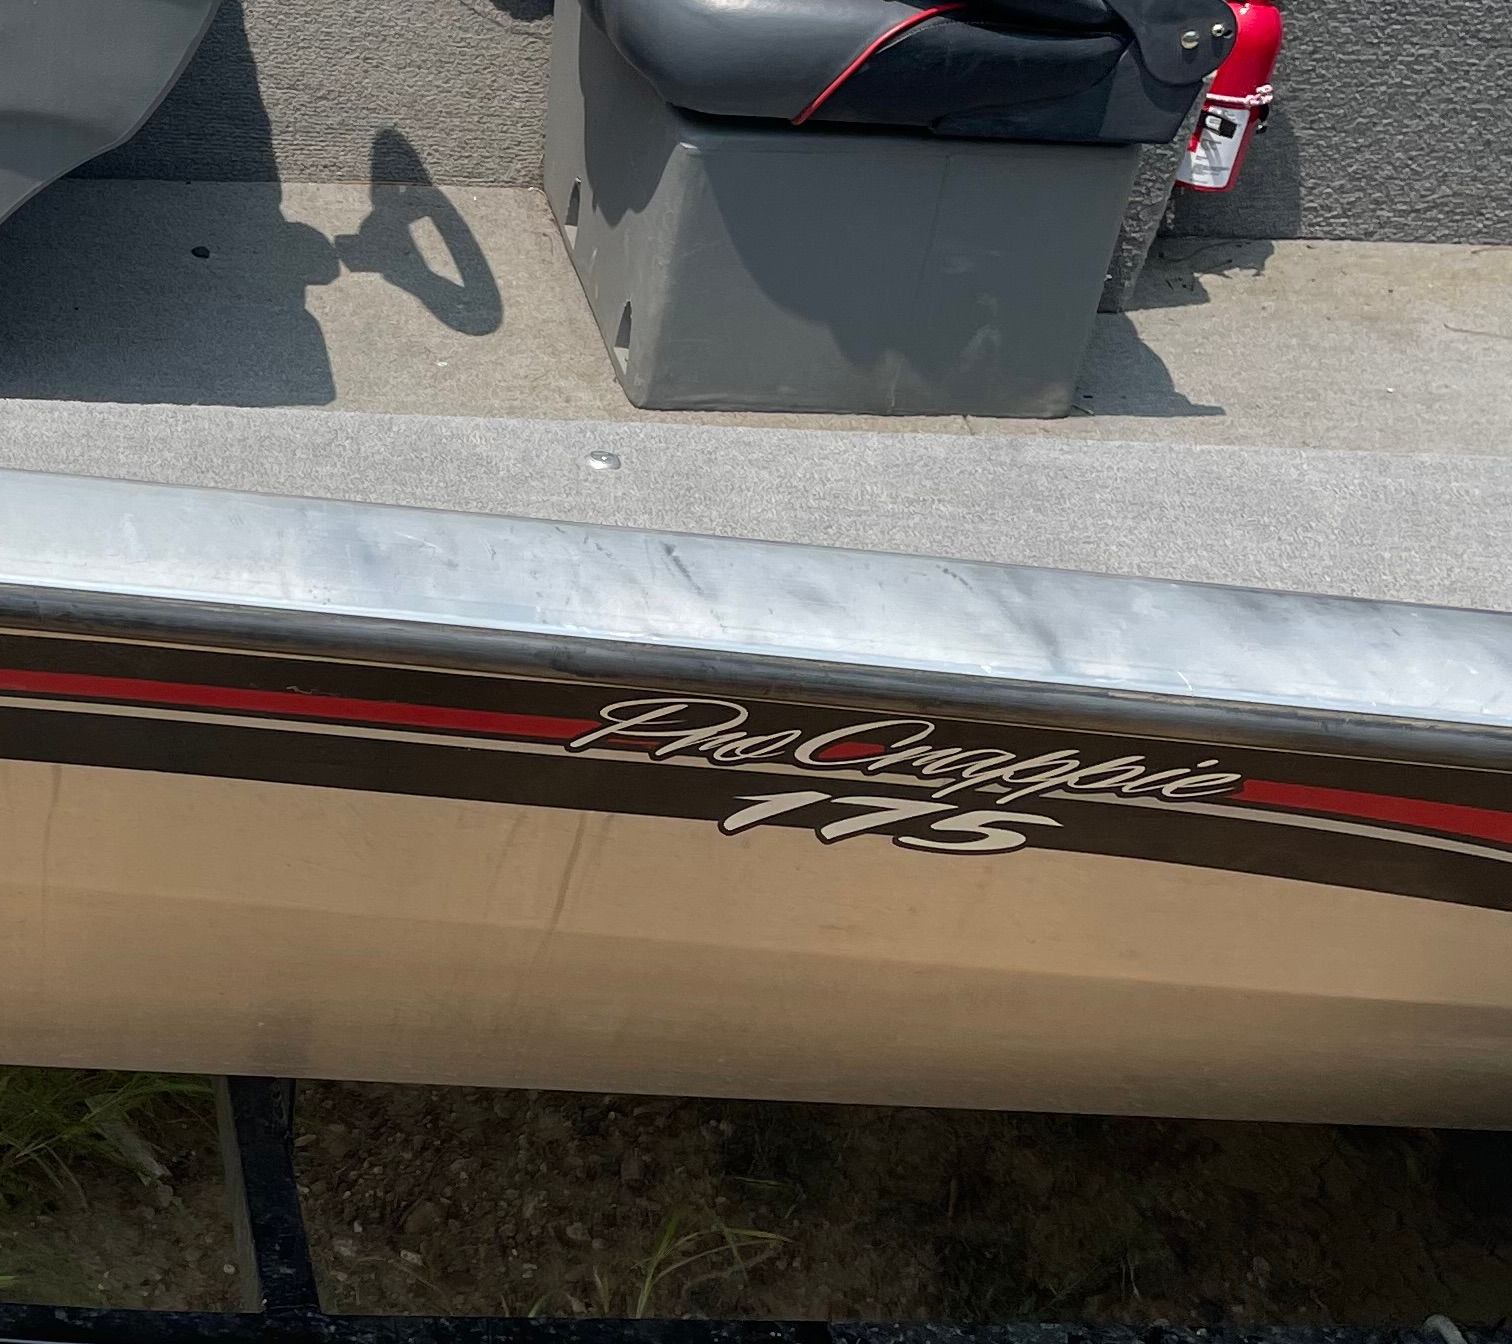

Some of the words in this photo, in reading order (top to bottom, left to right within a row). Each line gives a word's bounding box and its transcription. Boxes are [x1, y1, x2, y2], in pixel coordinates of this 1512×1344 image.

[569, 697, 802, 762] Pro
[794, 719, 1242, 804] Crappie
[720, 791, 1064, 851] 175
